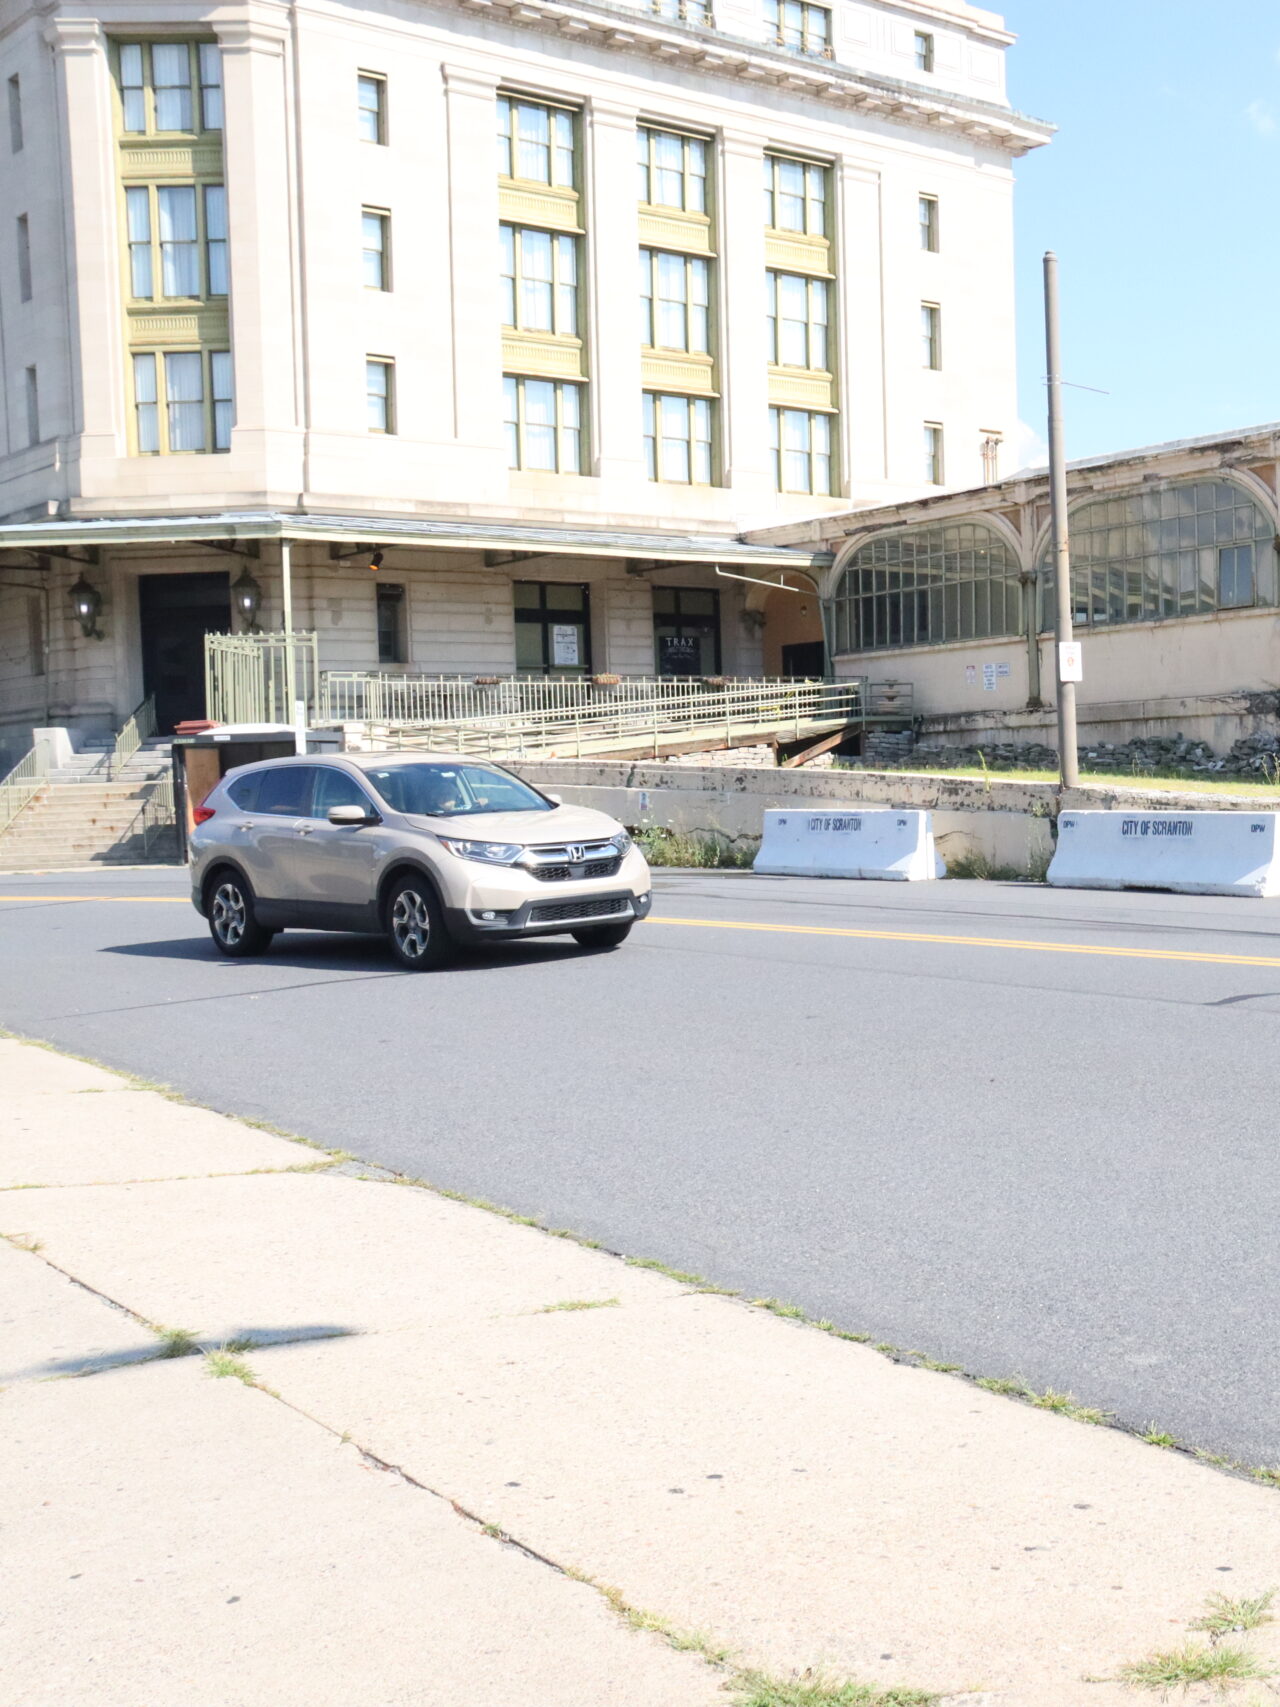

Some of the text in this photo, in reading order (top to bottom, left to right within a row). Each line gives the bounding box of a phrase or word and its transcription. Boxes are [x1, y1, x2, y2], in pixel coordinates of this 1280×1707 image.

[665, 637, 694, 647] TRAX
[810, 818, 862, 832] CITY OF SCRANTON
[1063, 820, 1075, 829] DPW
[1122, 820, 1193, 836] CITY OF SCRANTON
[1250, 823, 1266, 833] DPW
